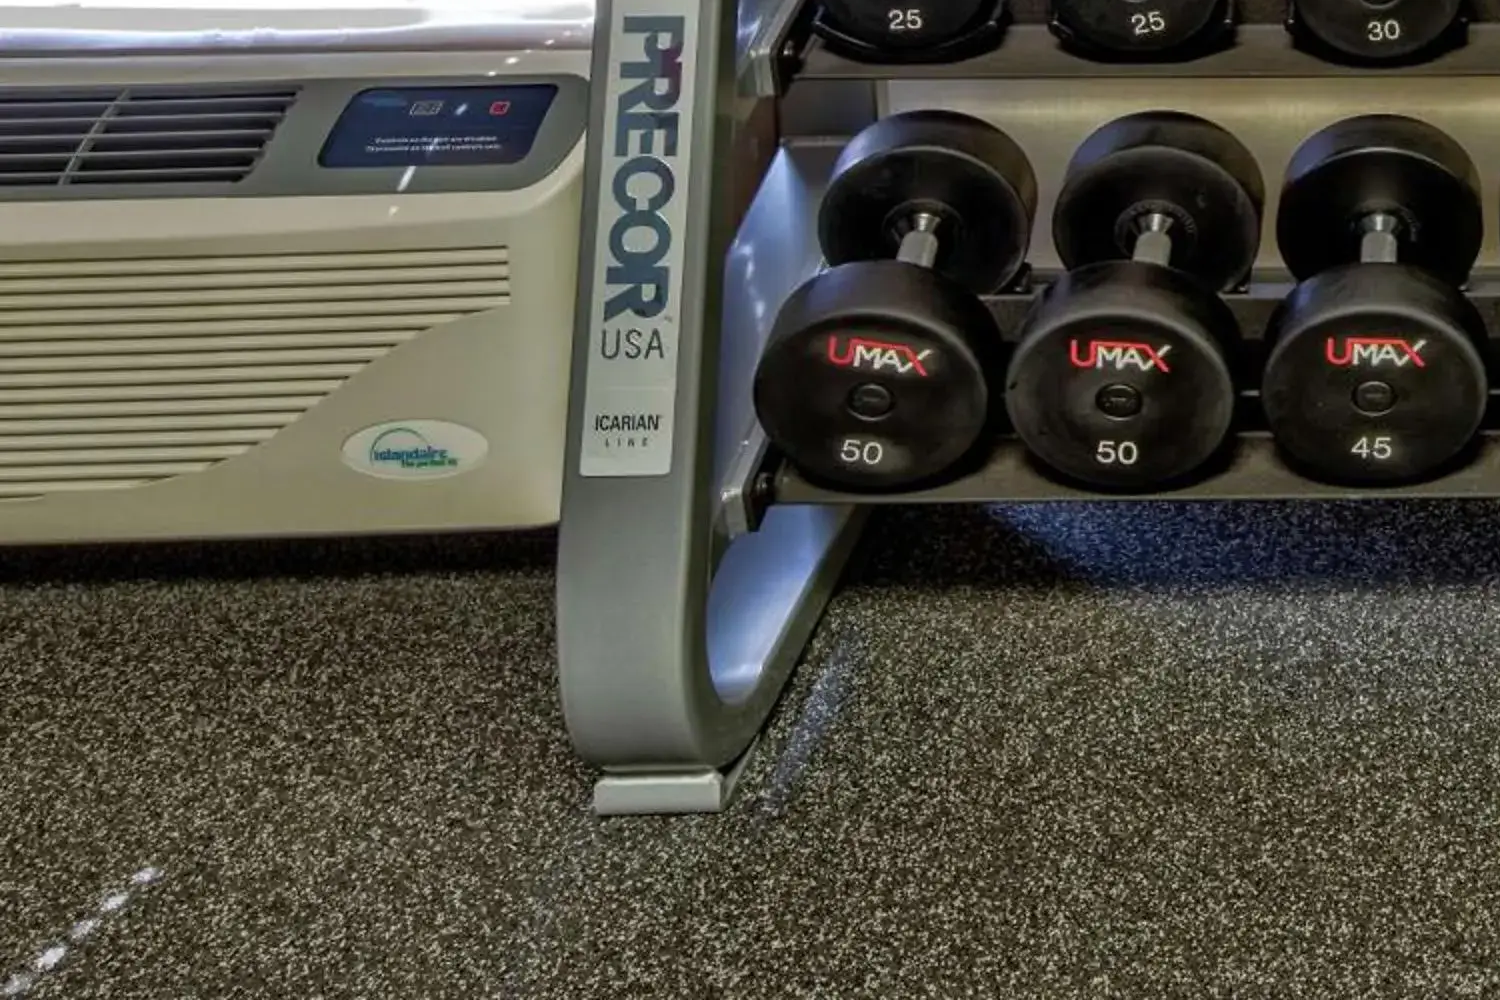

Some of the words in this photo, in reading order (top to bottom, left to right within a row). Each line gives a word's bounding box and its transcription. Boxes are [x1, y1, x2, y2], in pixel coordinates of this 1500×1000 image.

[888, 9, 922, 30] 25
[1131, 11, 1165, 35] 25
[1367, 19, 1401, 41] 30
[604, 14, 686, 324] PRECOR
[601, 327, 665, 359] USA
[1069, 339, 1171, 372] UMAX
[1325, 336, 1427, 368] UMAX
[827, 336, 932, 377] UMAX
[595, 414, 661, 431] ICARIAN
[840, 439, 884, 465] 50
[1096, 440, 1138, 465] 50
[1351, 436, 1392, 460] 45
